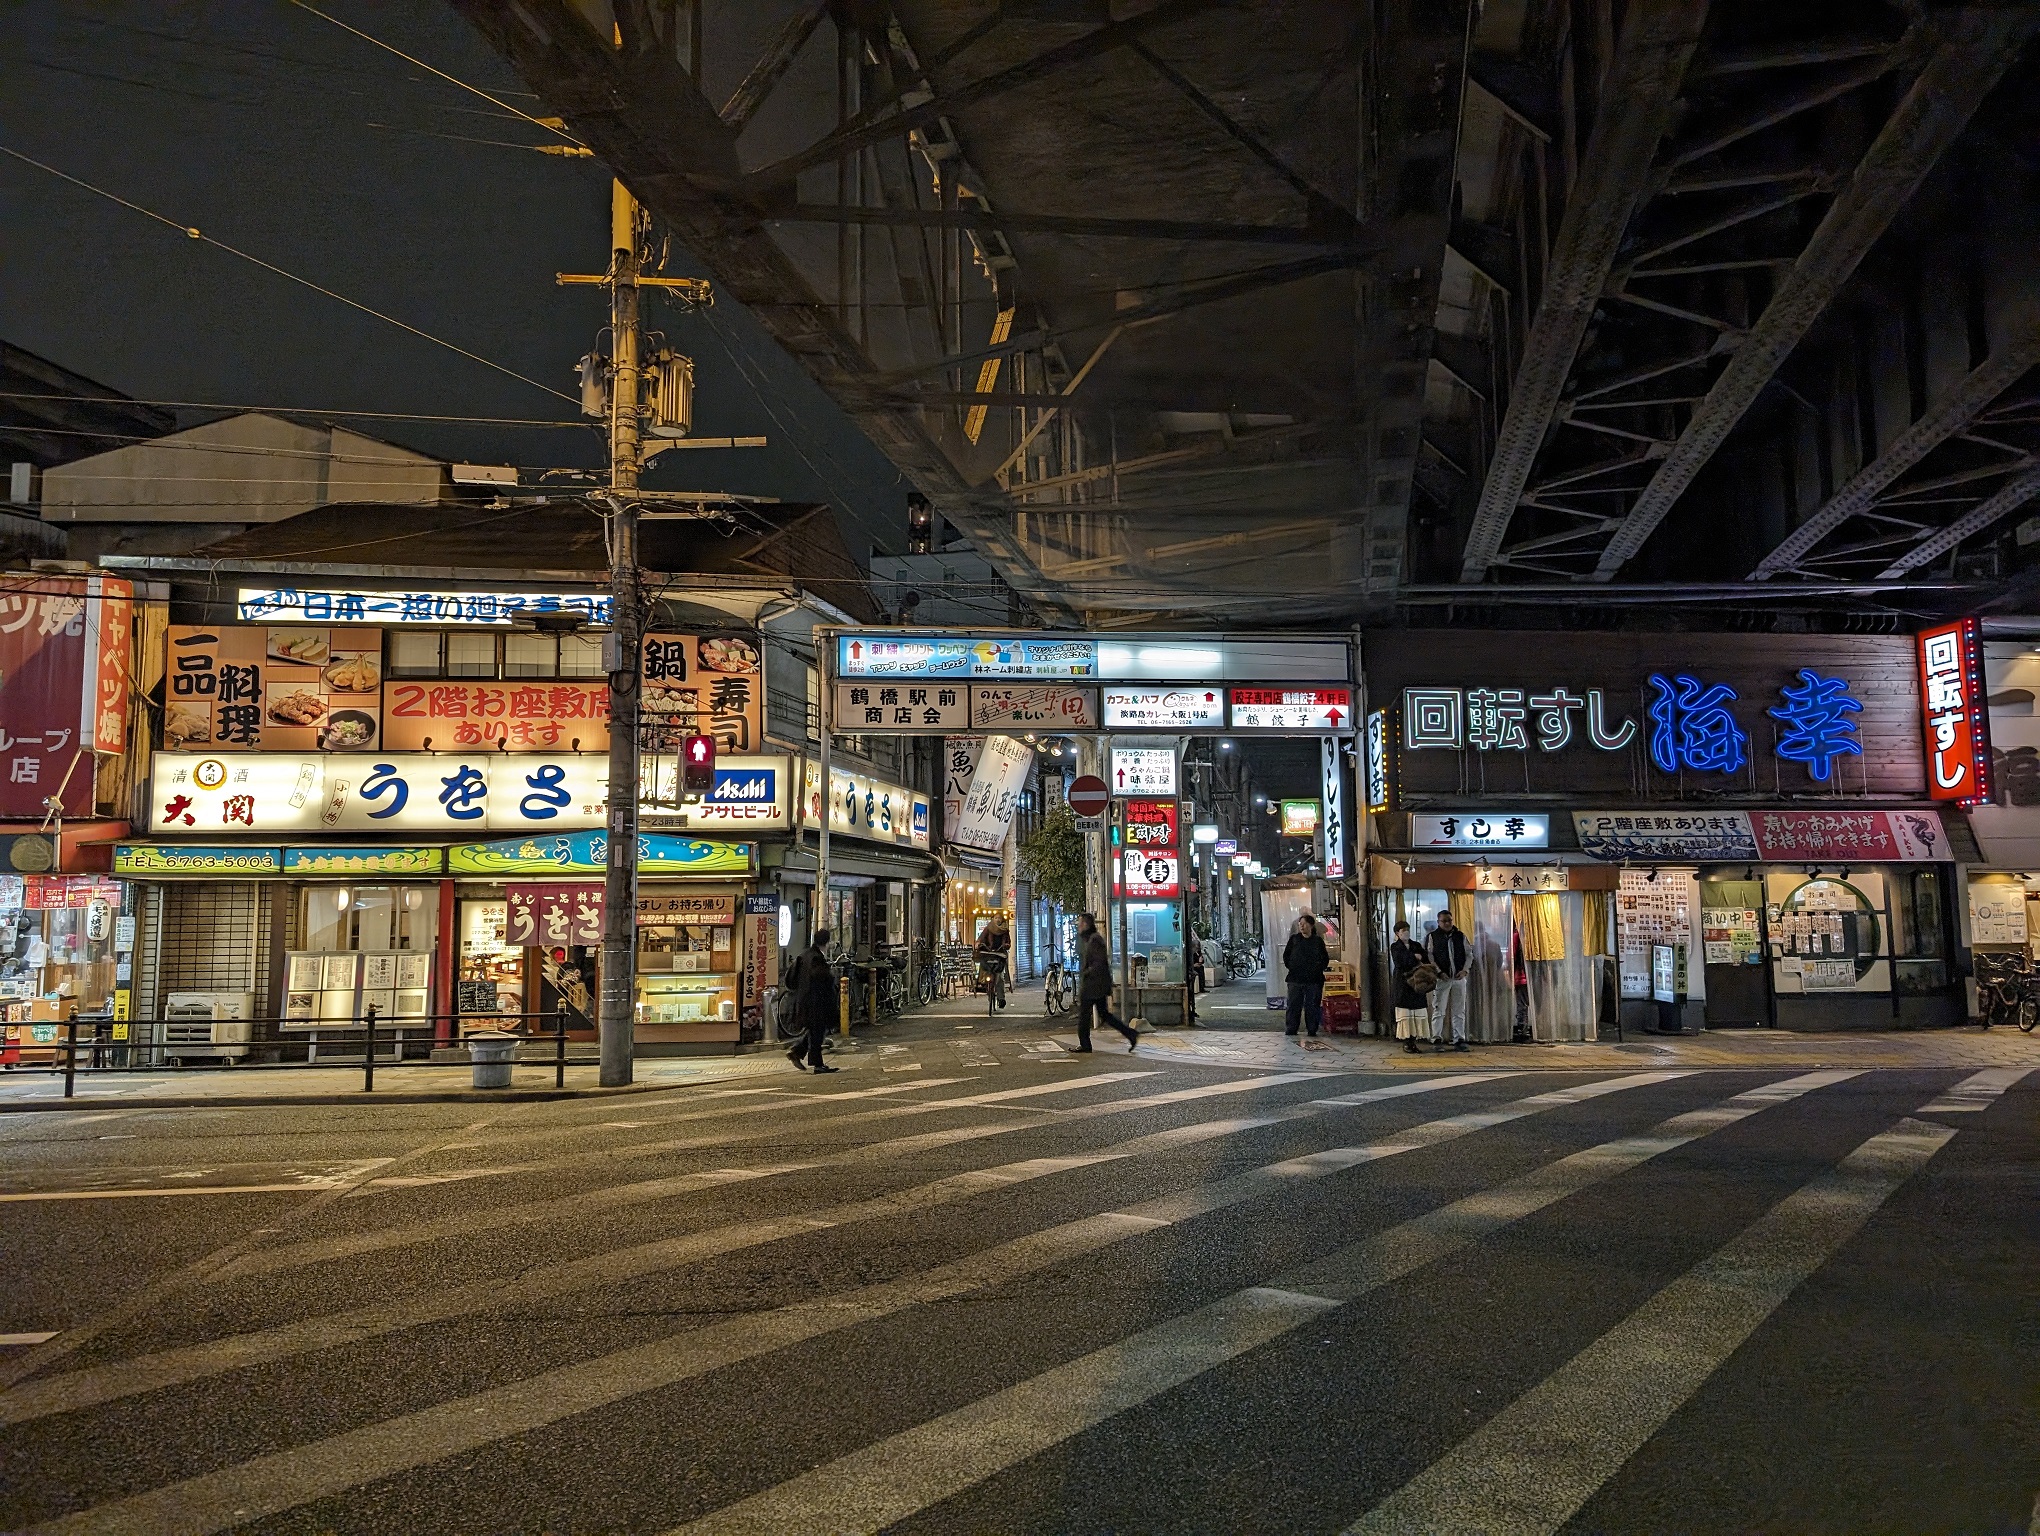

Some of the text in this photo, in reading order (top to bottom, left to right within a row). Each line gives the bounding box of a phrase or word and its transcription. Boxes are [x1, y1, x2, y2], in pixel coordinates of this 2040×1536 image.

[99, 584, 127, 748] キャベツ焼
[644, 638, 687, 682] 鍋
[217, 663, 262, 744] 料理
[850, 688, 957, 707] 鶴橋駅前
[980, 690, 1012, 700] のんで
[710, 676, 751, 751] 寿司
[864, 706, 942, 725] 商店会
[1012, 710, 1045, 720] 楽しい
[1120, 709, 1209, 719] 淡路島カレー大阪1号店
[1403, 686, 1639, 753] 回転すし
[1923, 630, 1967, 790] 回転すし
[452, 721, 567, 746] あります
[9, 756, 41, 784] 店
[171, 767, 250, 784] 清 酒
[358, 763, 572, 820] うをさ
[714, 777, 767, 800] Asahi
[162, 794, 255, 827] 大関
[582, 804, 609, 815] 営業
[700, 805, 781, 819] アサヒビール
[1439, 817, 1526, 841] すし幸
[1596, 816, 1741, 831] 2階座敷あります
[1762, 814, 1874, 833] 寿しのおみやげ
[1762, 831, 1889, 850] お持ち帰りできます
[122, 856, 274, 869] TEL.6763-5003
[1146, 860, 1168, 882] 碁
[1480, 872, 1569, 888] 立ち食い寿司
[543, 892, 570, 904] 一品
[576, 891, 603, 904] 料理
[668, 898, 726, 911] お持ち帰り
[513, 904, 601, 942] うをさ
